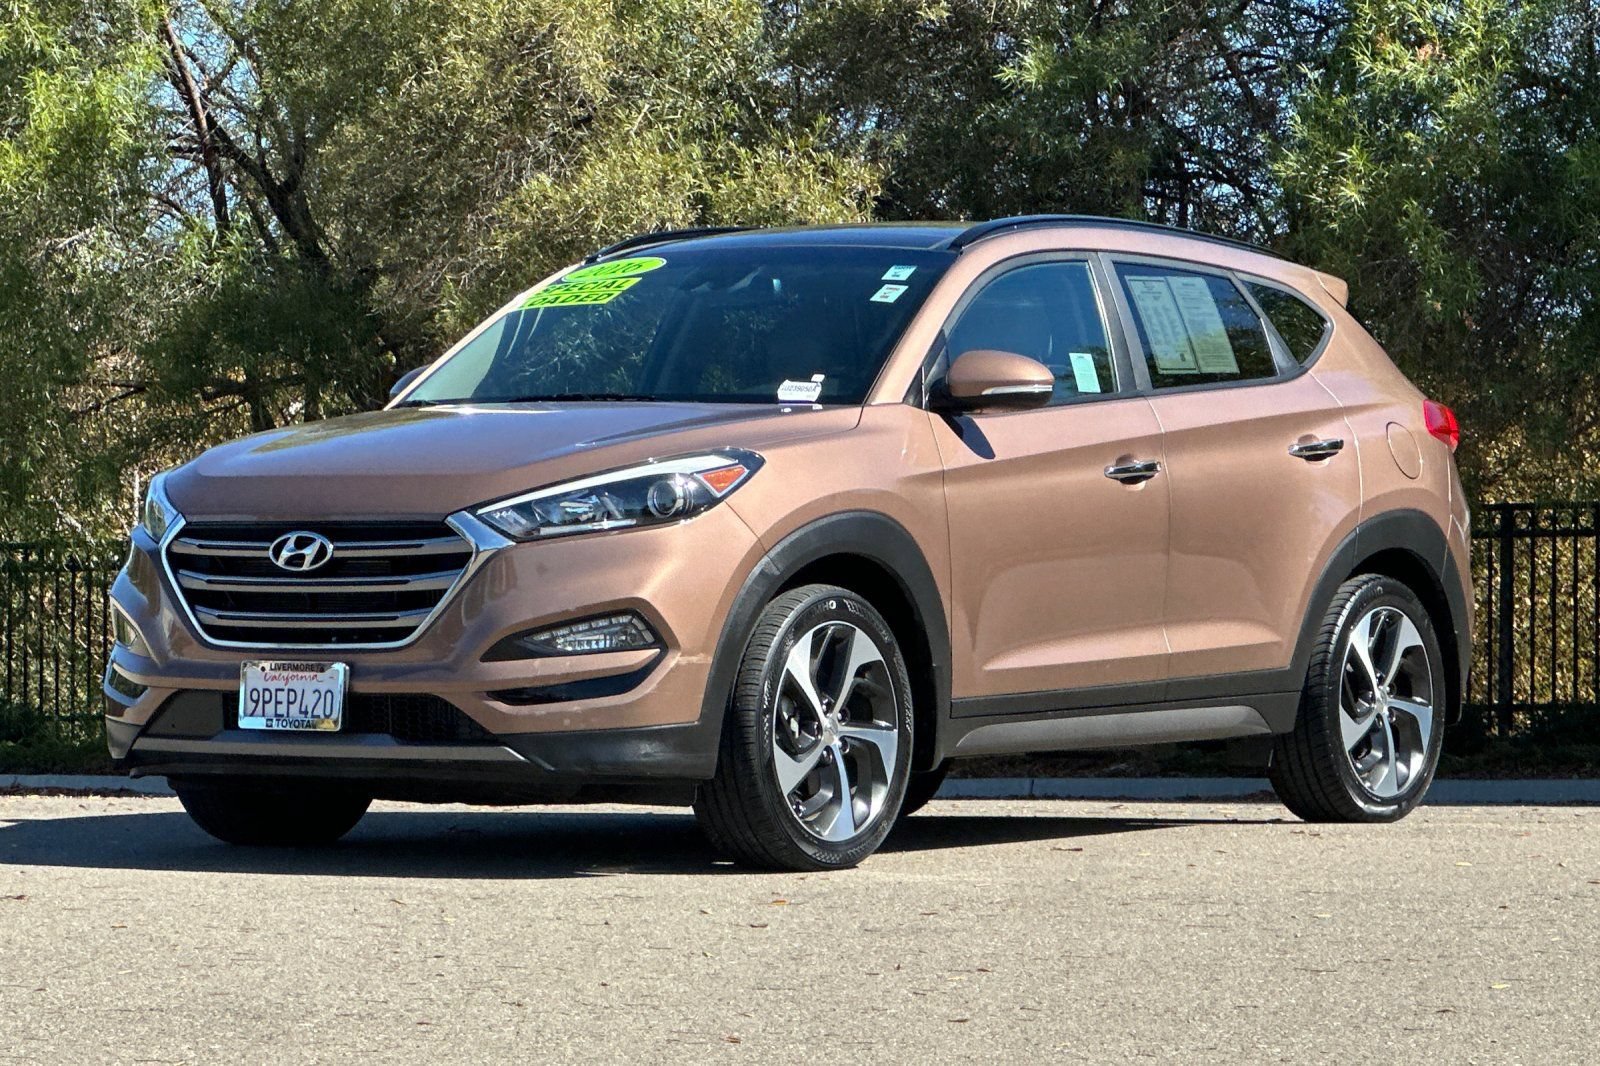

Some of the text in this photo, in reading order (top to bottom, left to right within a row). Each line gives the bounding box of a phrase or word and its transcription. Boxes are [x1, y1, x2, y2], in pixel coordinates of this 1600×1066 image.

[269, 662, 317, 672] LIVERMORE
[263, 671, 322, 687] California
[249, 687, 334, 719] 9PEP420
[275, 718, 312, 729] TOYOTA
